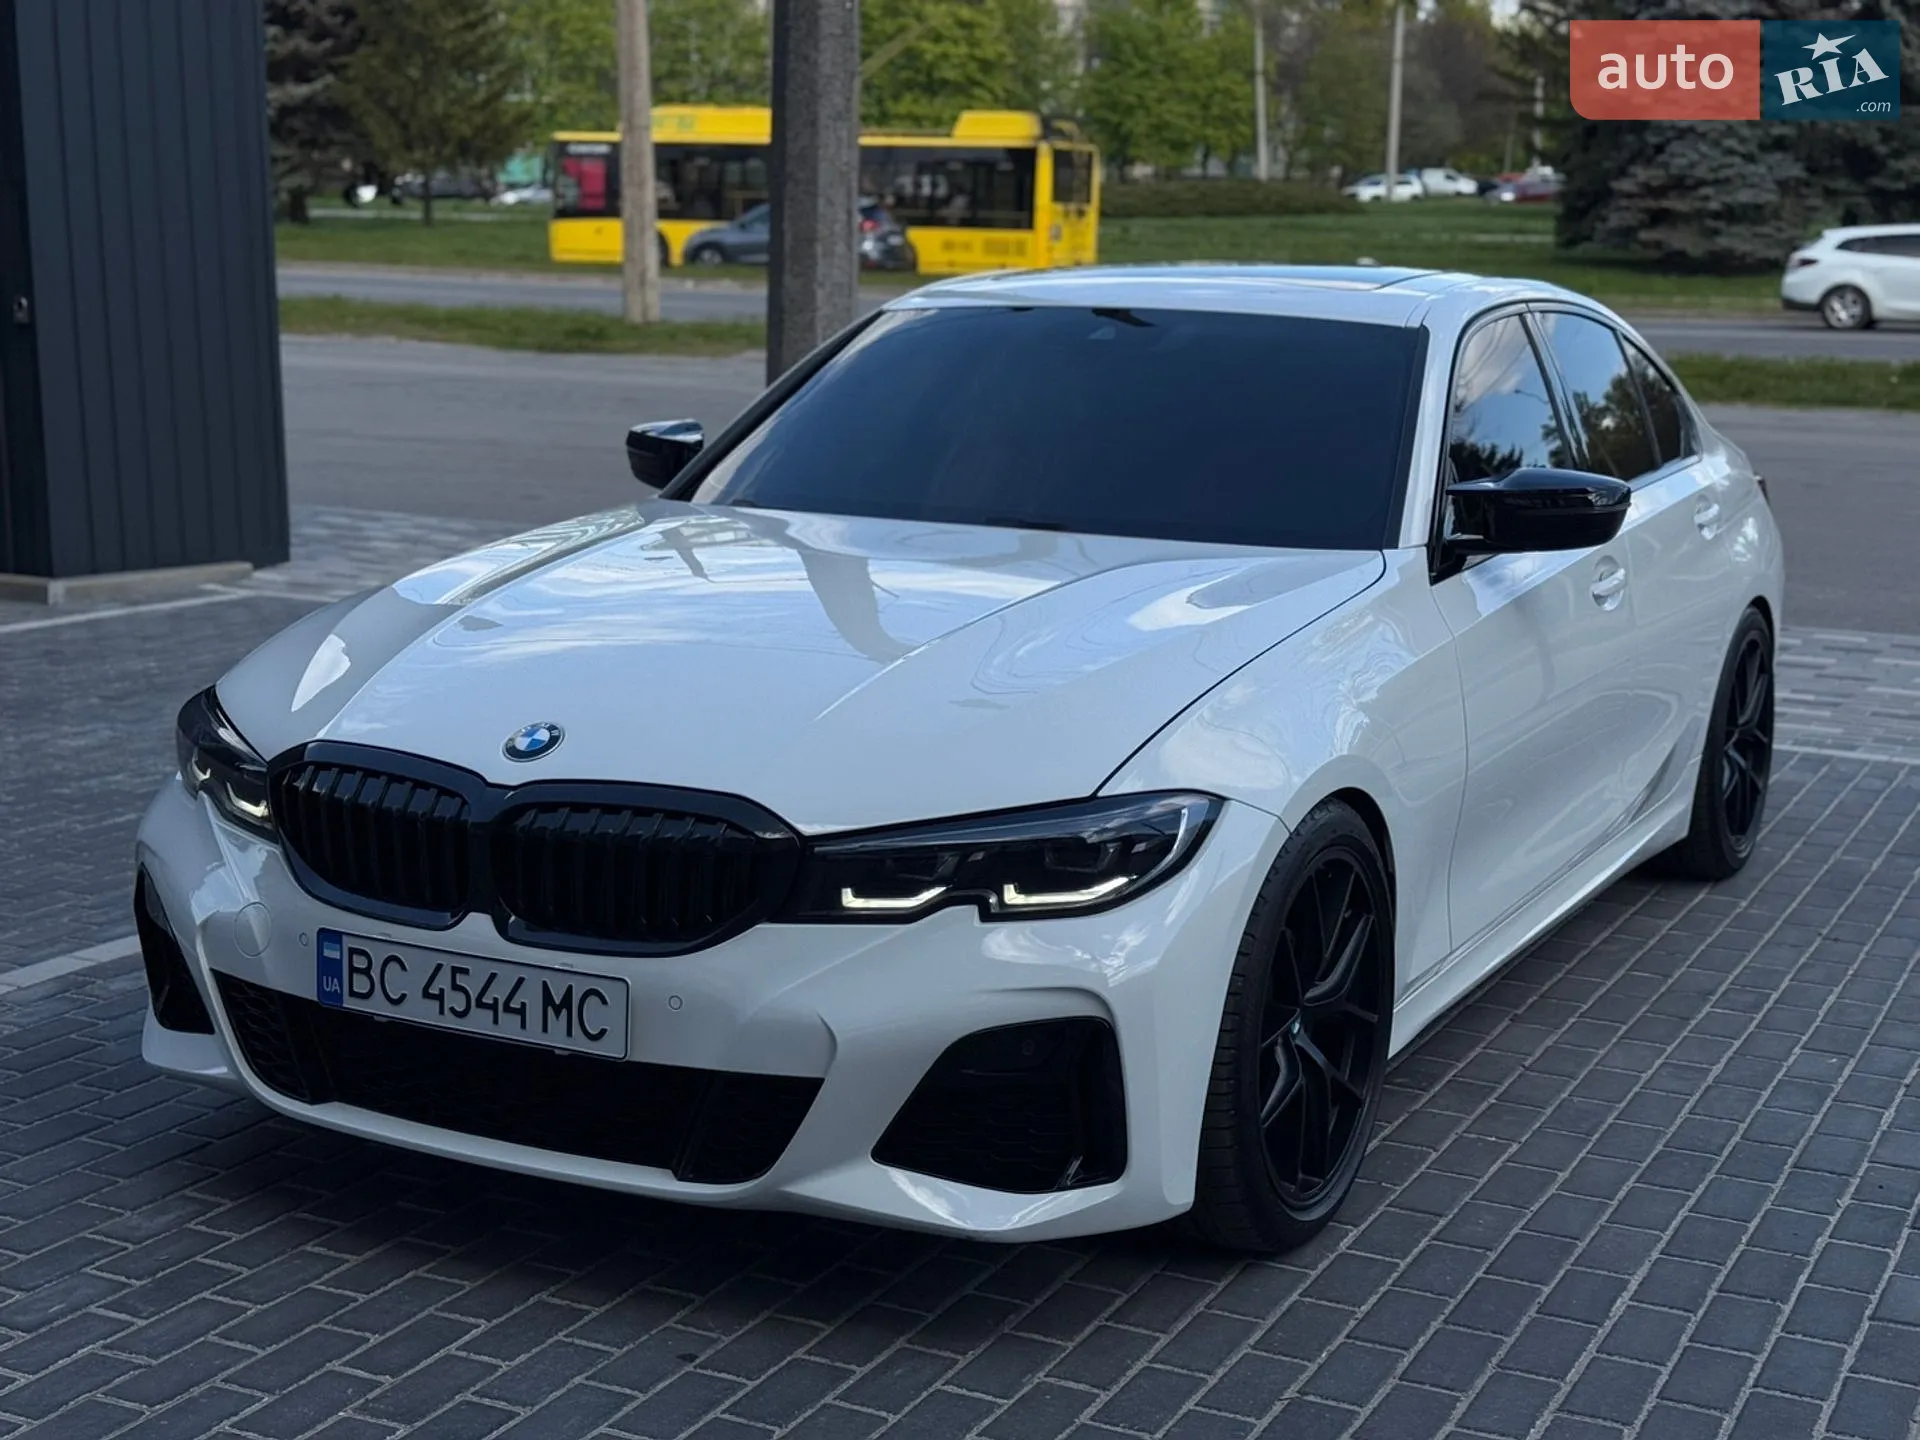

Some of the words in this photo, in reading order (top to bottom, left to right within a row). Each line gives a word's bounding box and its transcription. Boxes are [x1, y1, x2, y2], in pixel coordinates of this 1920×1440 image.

[323, 976, 341, 994] UA
[348, 946, 409, 1006] BC
[421, 963, 528, 1030] 4544
[541, 980, 609, 1042] MC
